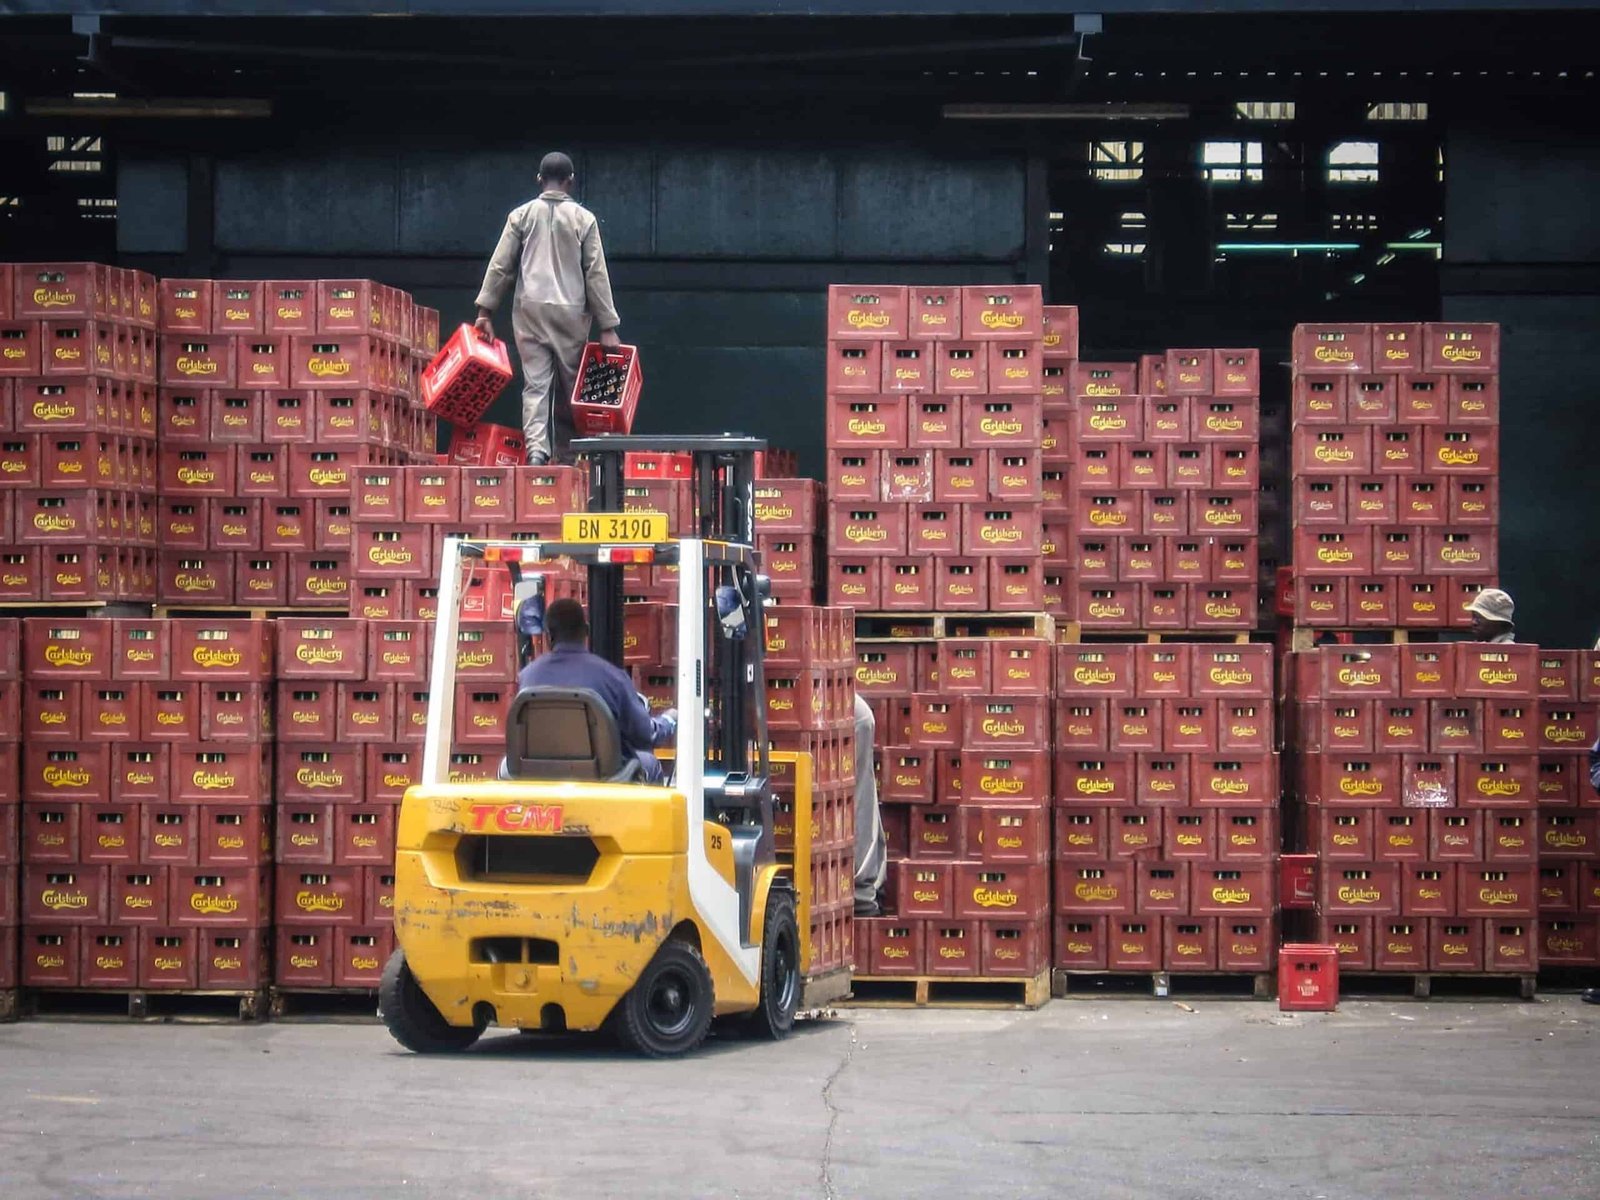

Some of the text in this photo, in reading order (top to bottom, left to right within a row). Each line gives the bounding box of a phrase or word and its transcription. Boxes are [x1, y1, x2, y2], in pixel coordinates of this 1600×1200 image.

[34, 289, 75, 307] Carlsberg
[848, 310, 889, 328] Carlsberg
[981, 311, 1022, 328] Carlsberg
[1315, 347, 1354, 362] Carlsberg
[1442, 345, 1481, 361] Carlsberg
[177, 358, 216, 374] Carlsberg
[309, 358, 350, 376] Carlsberg
[1086, 384, 1120, 396] Carlsberg
[33, 402, 75, 420] Carlsberg
[848, 419, 885, 435] Carlsberg
[980, 419, 1021, 436] Carlsberg
[1090, 415, 1126, 430] Carlsberg
[1206, 417, 1242, 431] Carlsberg
[1315, 446, 1353, 462] Carlsberg
[178, 468, 214, 484] Carlsberg
[310, 469, 346, 485] Carlsberg
[34, 514, 75, 531] Carlsberg
[1090, 510, 1126, 525] Carlsberg
[1205, 510, 1241, 525] Carlsberg
[579, 519, 651, 539] BN 3190
[846, 526, 886, 542] Carlsberg
[981, 526, 1022, 543] Carlsberg
[369, 547, 411, 565] Carlsberg
[1317, 548, 1352, 563] Carlsberg
[1441, 547, 1480, 563] Carlsberg
[175, 574, 215, 591] Carlsberg
[306, 577, 346, 594] Carlsberg
[1089, 603, 1124, 618] Carlsberg
[1205, 603, 1240, 618] Carlsberg
[46, 646, 93, 666] Carlsberg
[193, 647, 241, 667] Carlsberg
[297, 645, 342, 664] Carlsberg
[855, 667, 896, 685] Carlsberg
[1074, 667, 1115, 685] Carlsberg
[1210, 668, 1251, 685] Carlsberg
[1339, 669, 1380, 686] Carlsberg
[1479, 668, 1517, 684] Carlsberg
[983, 719, 1024, 737] Carlsberg
[1545, 725, 1585, 742] Carlsberg
[44, 767, 90, 787] Carlsberg
[193, 771, 234, 789] Carlsberg
[297, 768, 342, 788] Carlsberg
[980, 776, 1023, 794] Carlsberg
[1211, 777, 1248, 794] Carlsberg
[1077, 778, 1114, 794] Carlsberg
[1340, 778, 1382, 795] Carlsberg
[1477, 778, 1520, 795] Carlsberg
[469, 804, 564, 832] TCM
[711, 835, 722, 850] 25
[42, 890, 87, 909] Carlsberg
[973, 888, 1016, 906] Carlsberg
[1075, 883, 1117, 901] Carlsberg
[1212, 887, 1250, 903] Carlsberg
[1338, 886, 1380, 904] Carlsberg
[1480, 888, 1517, 904] Carlsberg
[191, 893, 237, 913] Carlsberg
